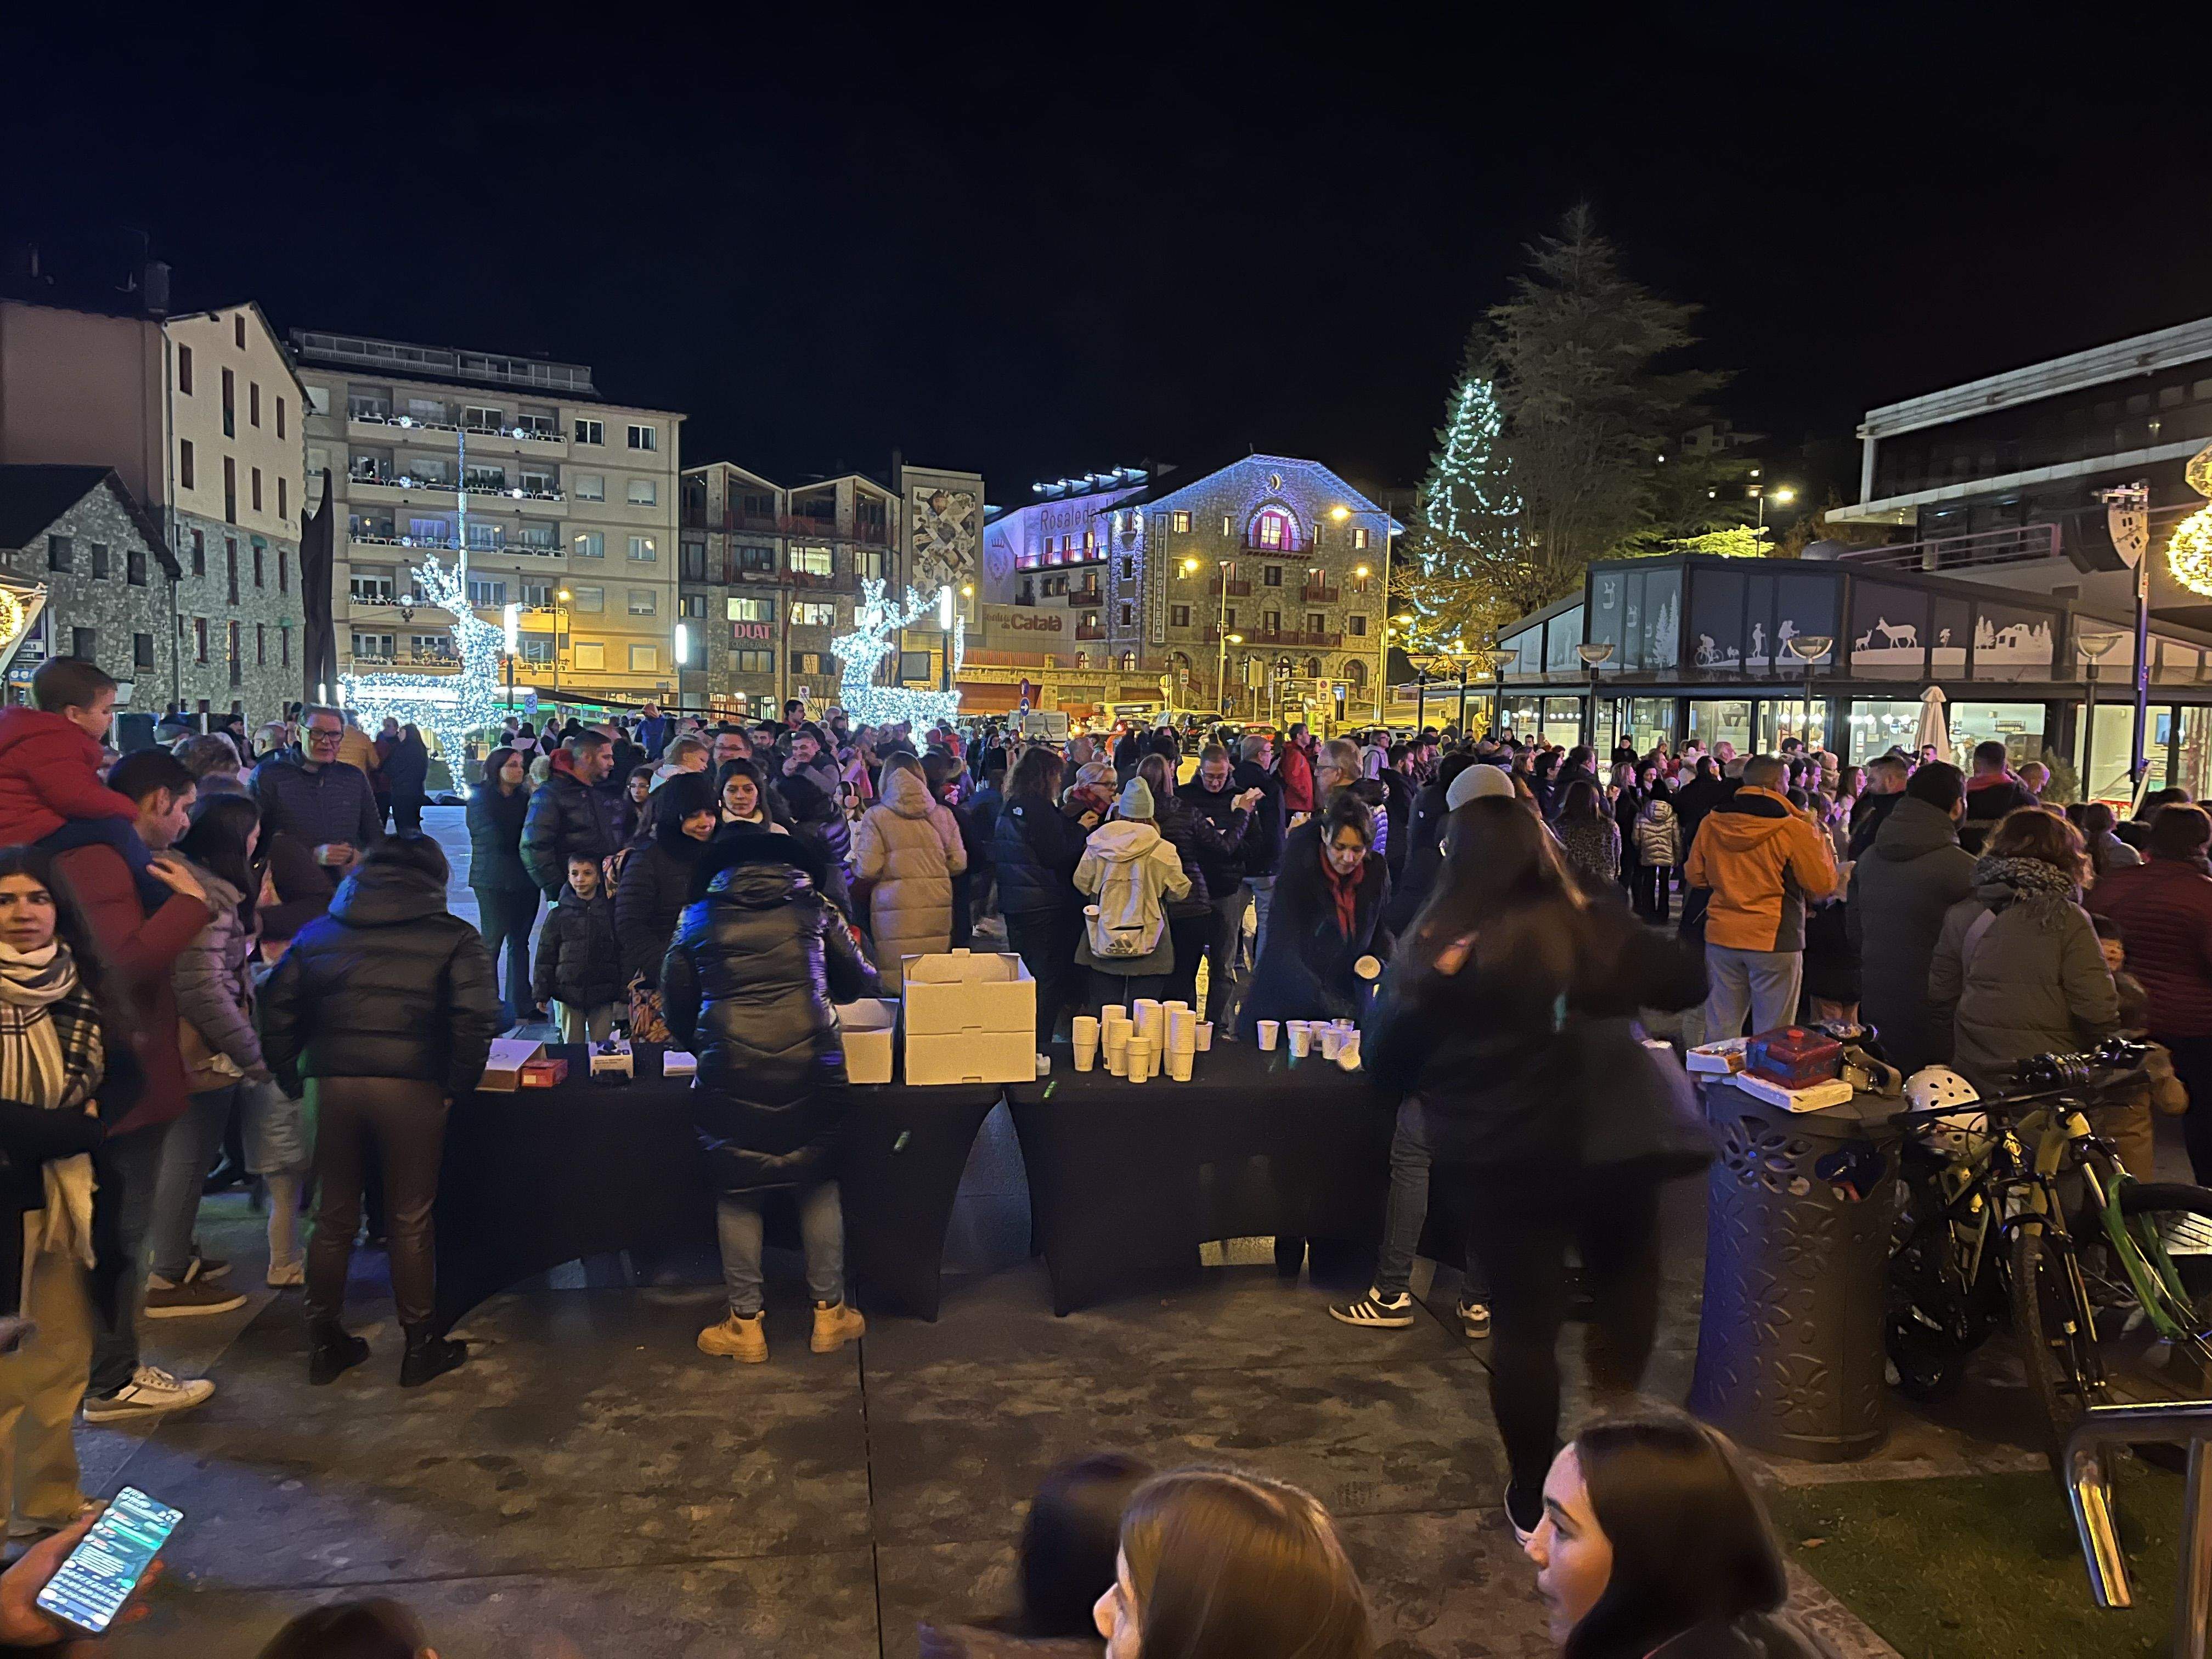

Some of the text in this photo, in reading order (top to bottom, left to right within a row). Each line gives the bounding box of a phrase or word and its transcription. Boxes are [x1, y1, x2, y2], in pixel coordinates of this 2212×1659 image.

[1041, 502, 1097, 531] Rosaleda
[1155, 571, 1164, 634] ROSALEDA
[734, 623, 771, 639] DUAT
[1011, 613, 1062, 632] Català
